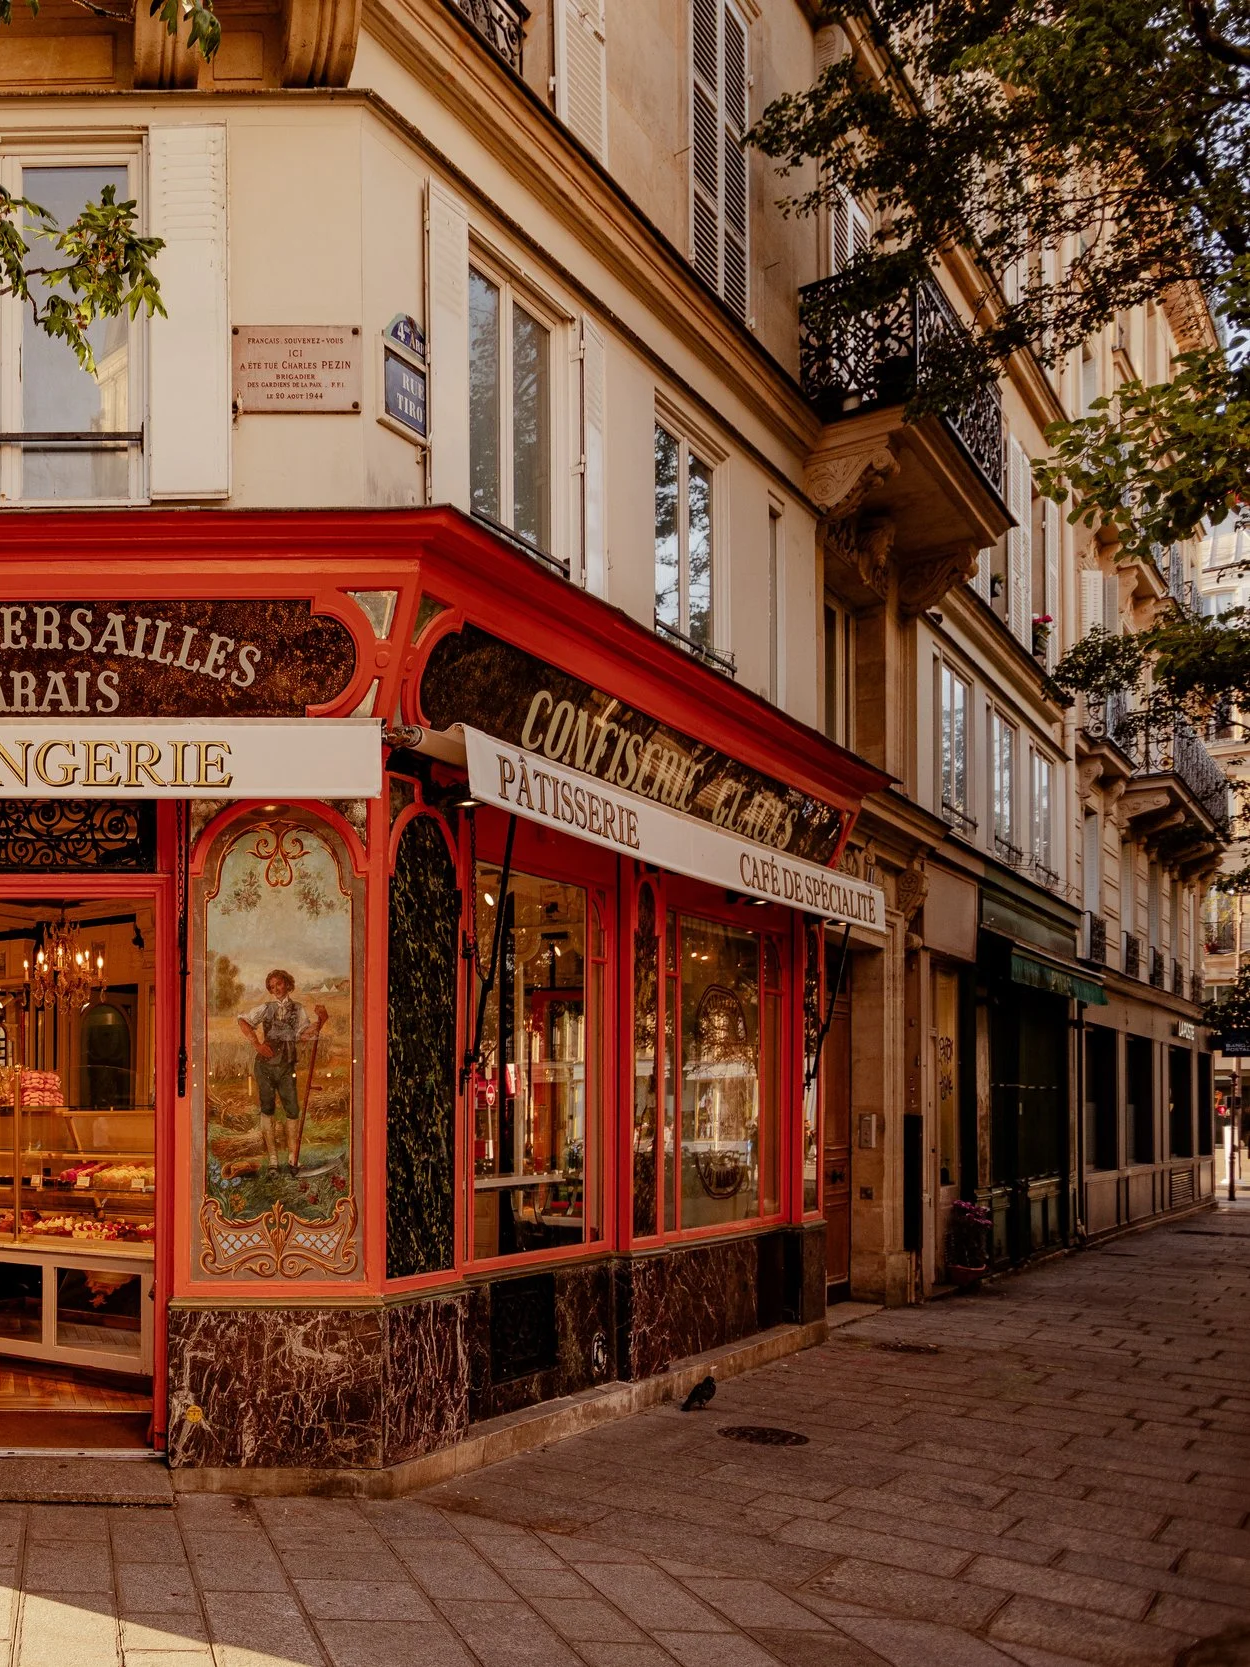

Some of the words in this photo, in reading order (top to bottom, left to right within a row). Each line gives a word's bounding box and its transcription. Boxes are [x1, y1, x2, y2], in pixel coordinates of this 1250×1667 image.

[288, 349, 303, 358] ICI
[321, 360, 351, 370] PEZIN
[496, 754, 640, 849] PÂTISSERIE
[521, 690, 704, 812] CONFISERIE
[712, 778, 798, 850] GLACES
[739, 852, 780, 896] CAFÉ
[782, 867, 804, 902] DE
[805, 873, 876, 924] SPÉCIALITÉ
